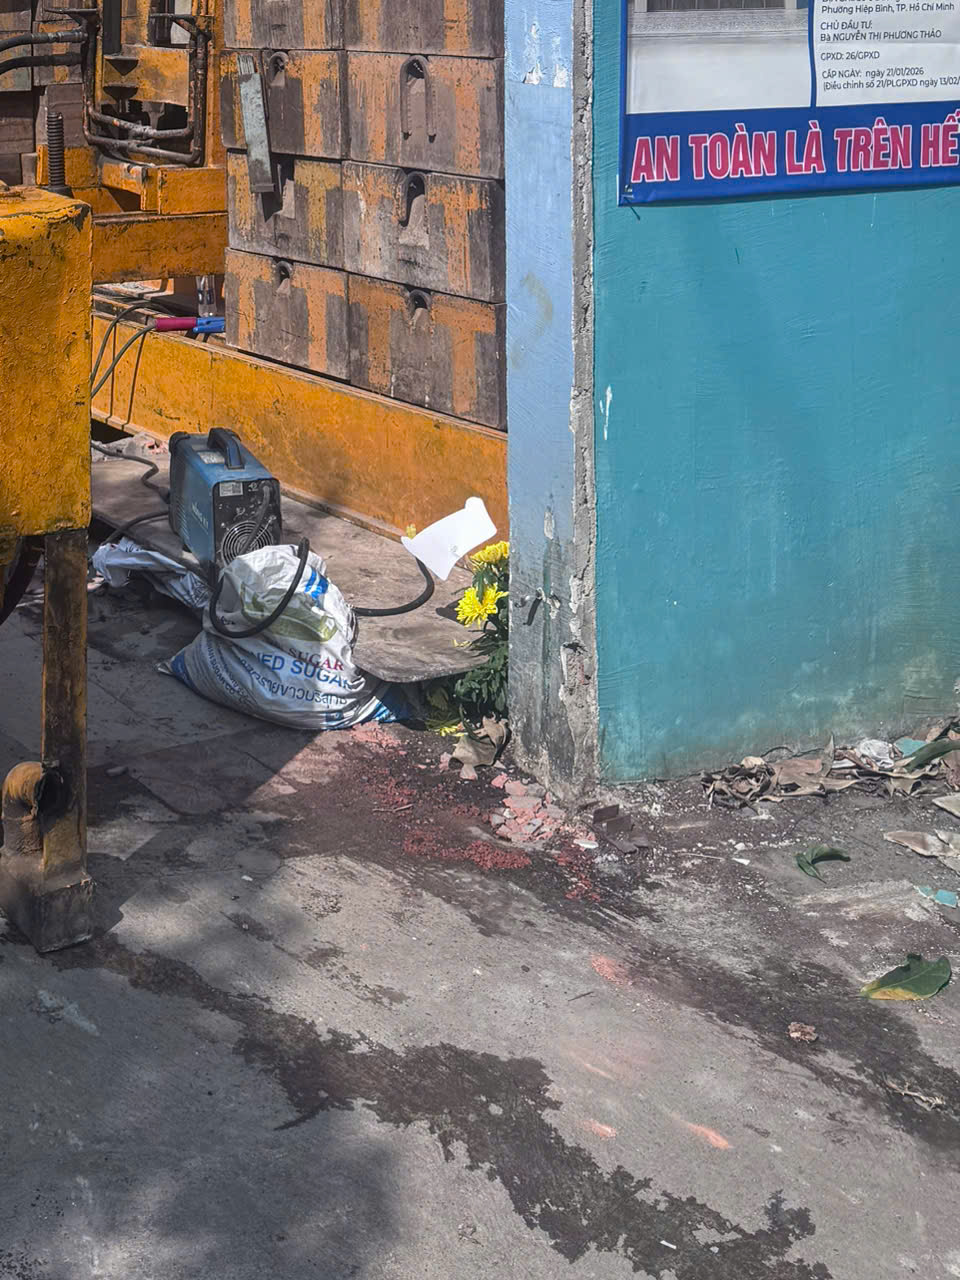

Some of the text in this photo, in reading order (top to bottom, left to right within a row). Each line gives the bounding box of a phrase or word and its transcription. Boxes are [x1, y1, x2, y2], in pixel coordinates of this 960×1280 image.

[896, 3, 908, 12] TP.
[936, 2, 954, 11] Minh
[820, 33, 831, 41] Bà
[832, 30, 866, 41] NGUYỄN
[883, 30, 919, 39] PHƯƠNG
[820, 51, 880, 61] GPXD: 26/GPXD
[865, 69, 885, 79] ngày
[920, 78, 938, 88] ngày
[630, 135, 680, 183] AN
[688, 123, 778, 180] TOÀN
[785, 120, 826, 175] LÀ
[833, 116, 913, 172] TRÊN
[289, 647, 344, 671] SUGAR
